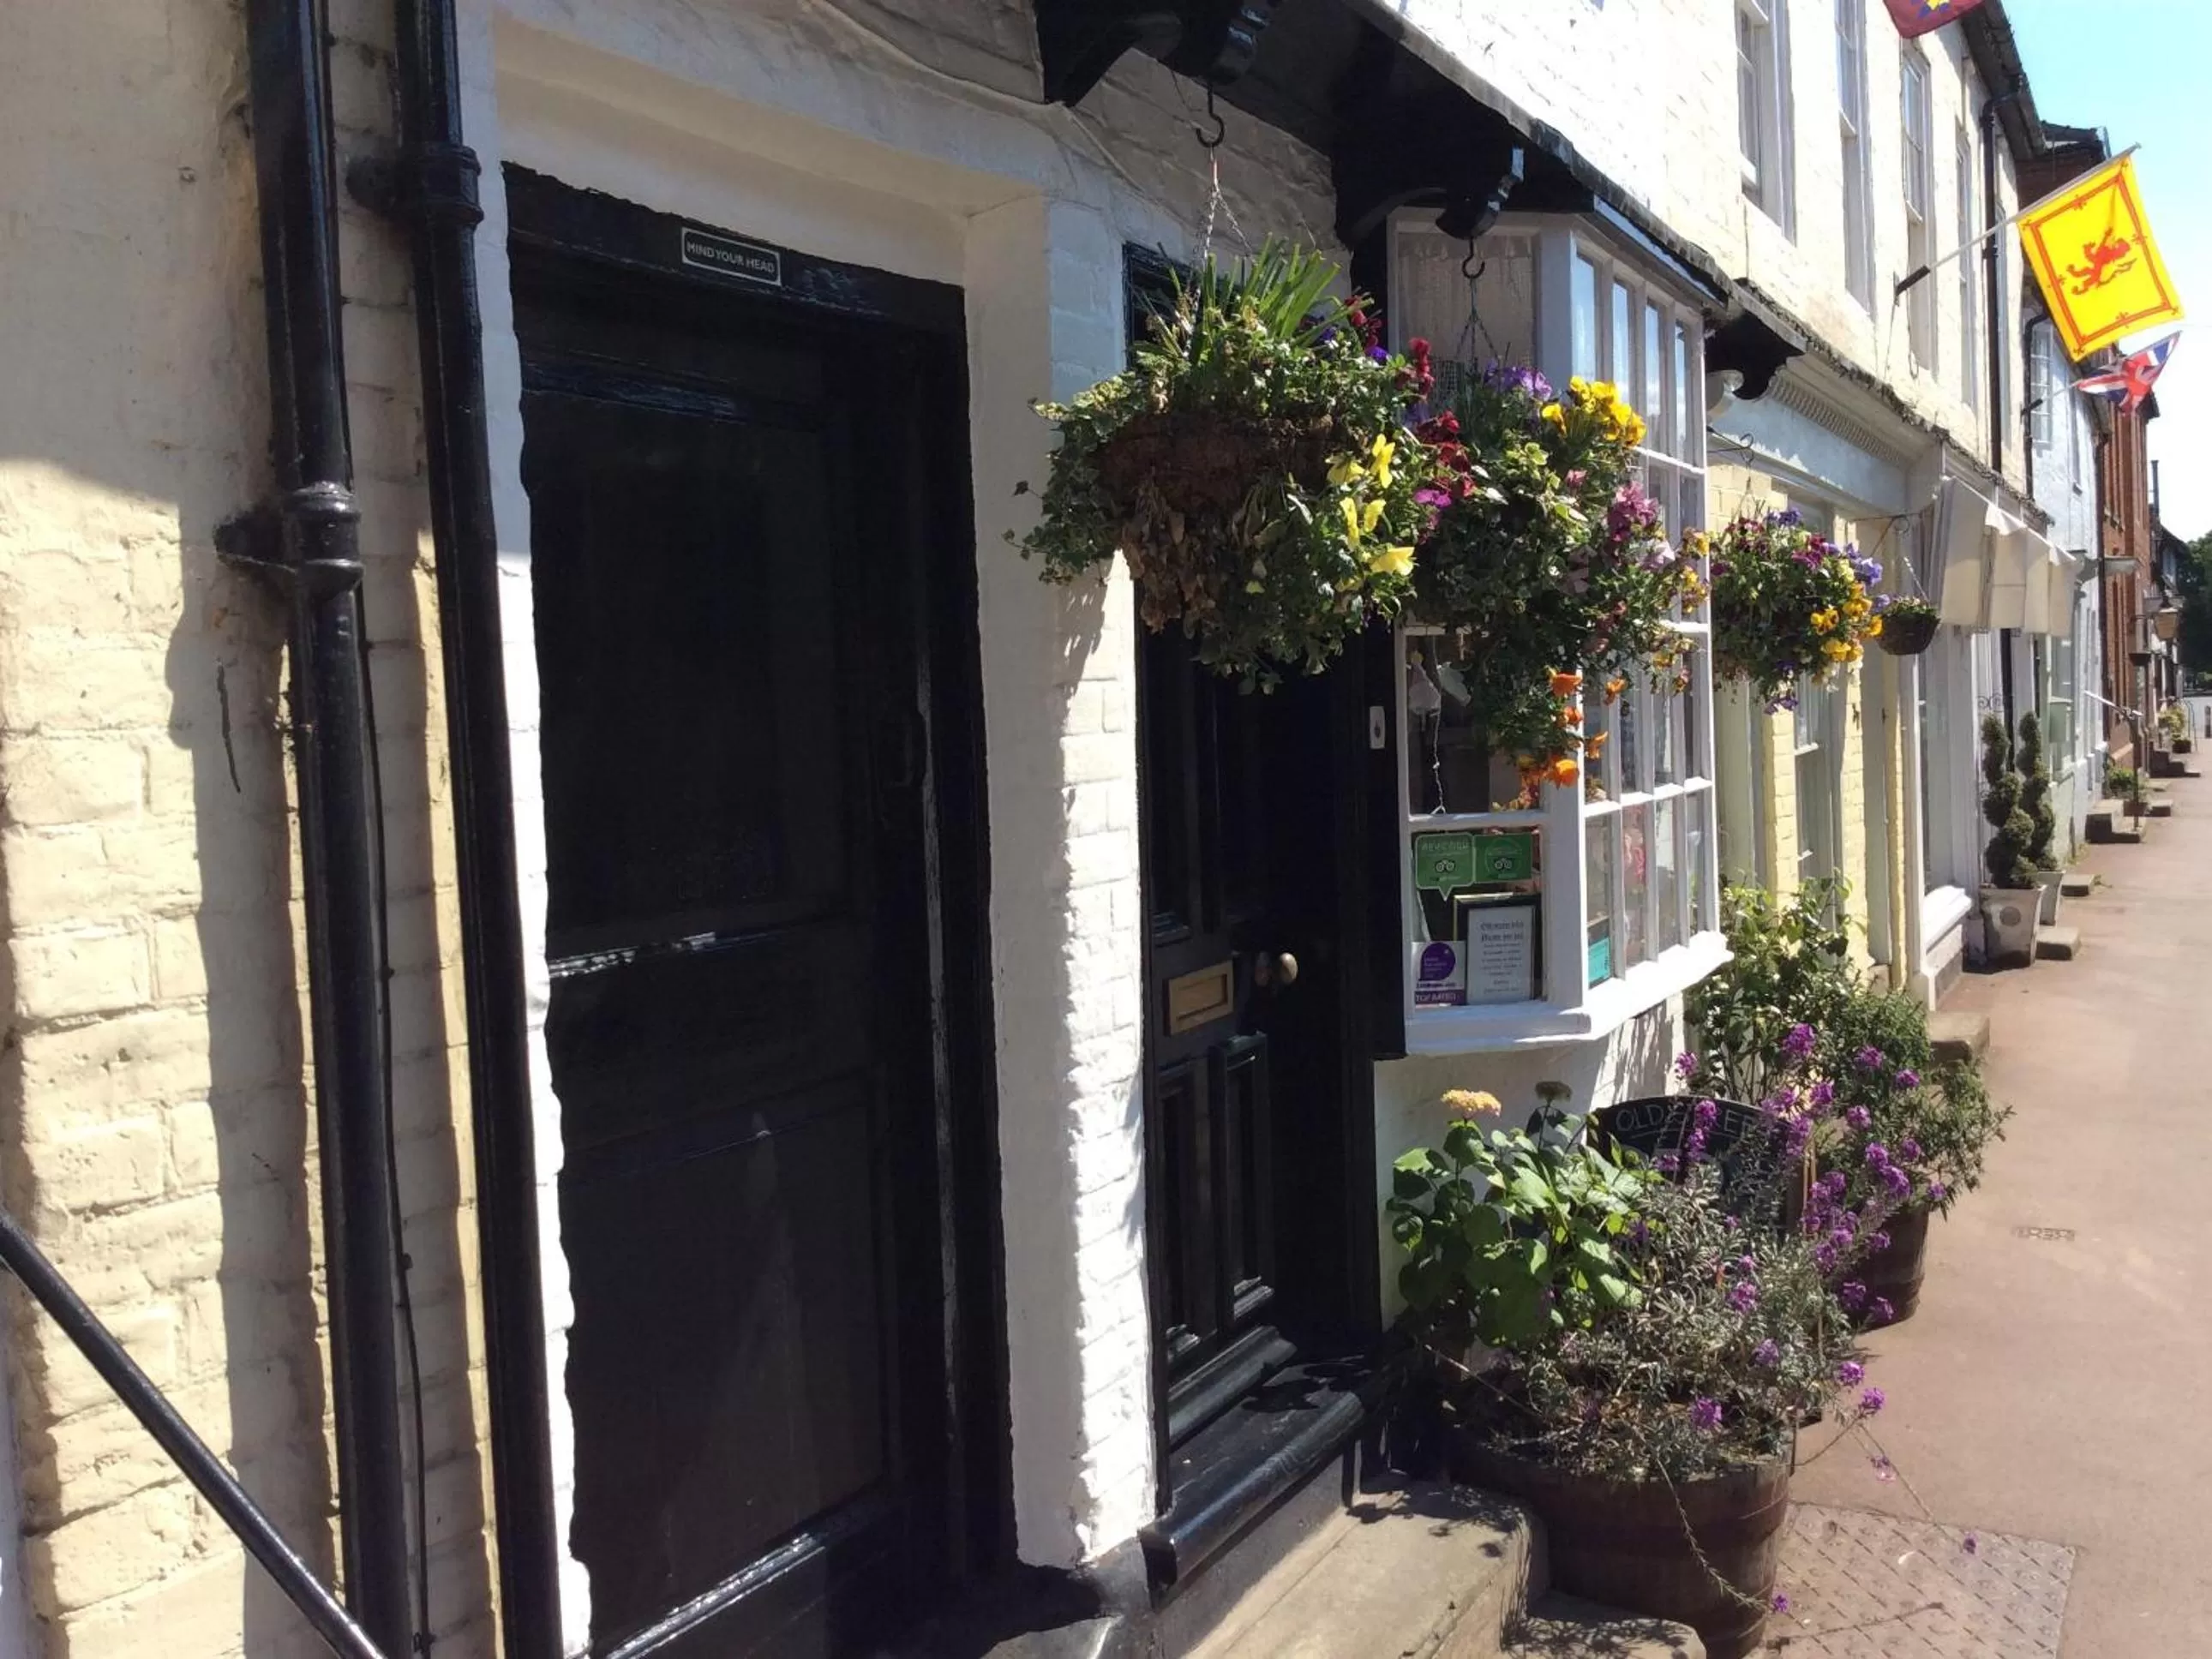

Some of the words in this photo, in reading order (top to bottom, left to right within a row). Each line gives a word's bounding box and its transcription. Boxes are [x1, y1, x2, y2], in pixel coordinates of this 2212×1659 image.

[686, 241, 715, 258] MIND
[715, 249, 744, 267] YOUR
[746, 257, 775, 273] HEAD
[1616, 1104, 1664, 1132] OLD
